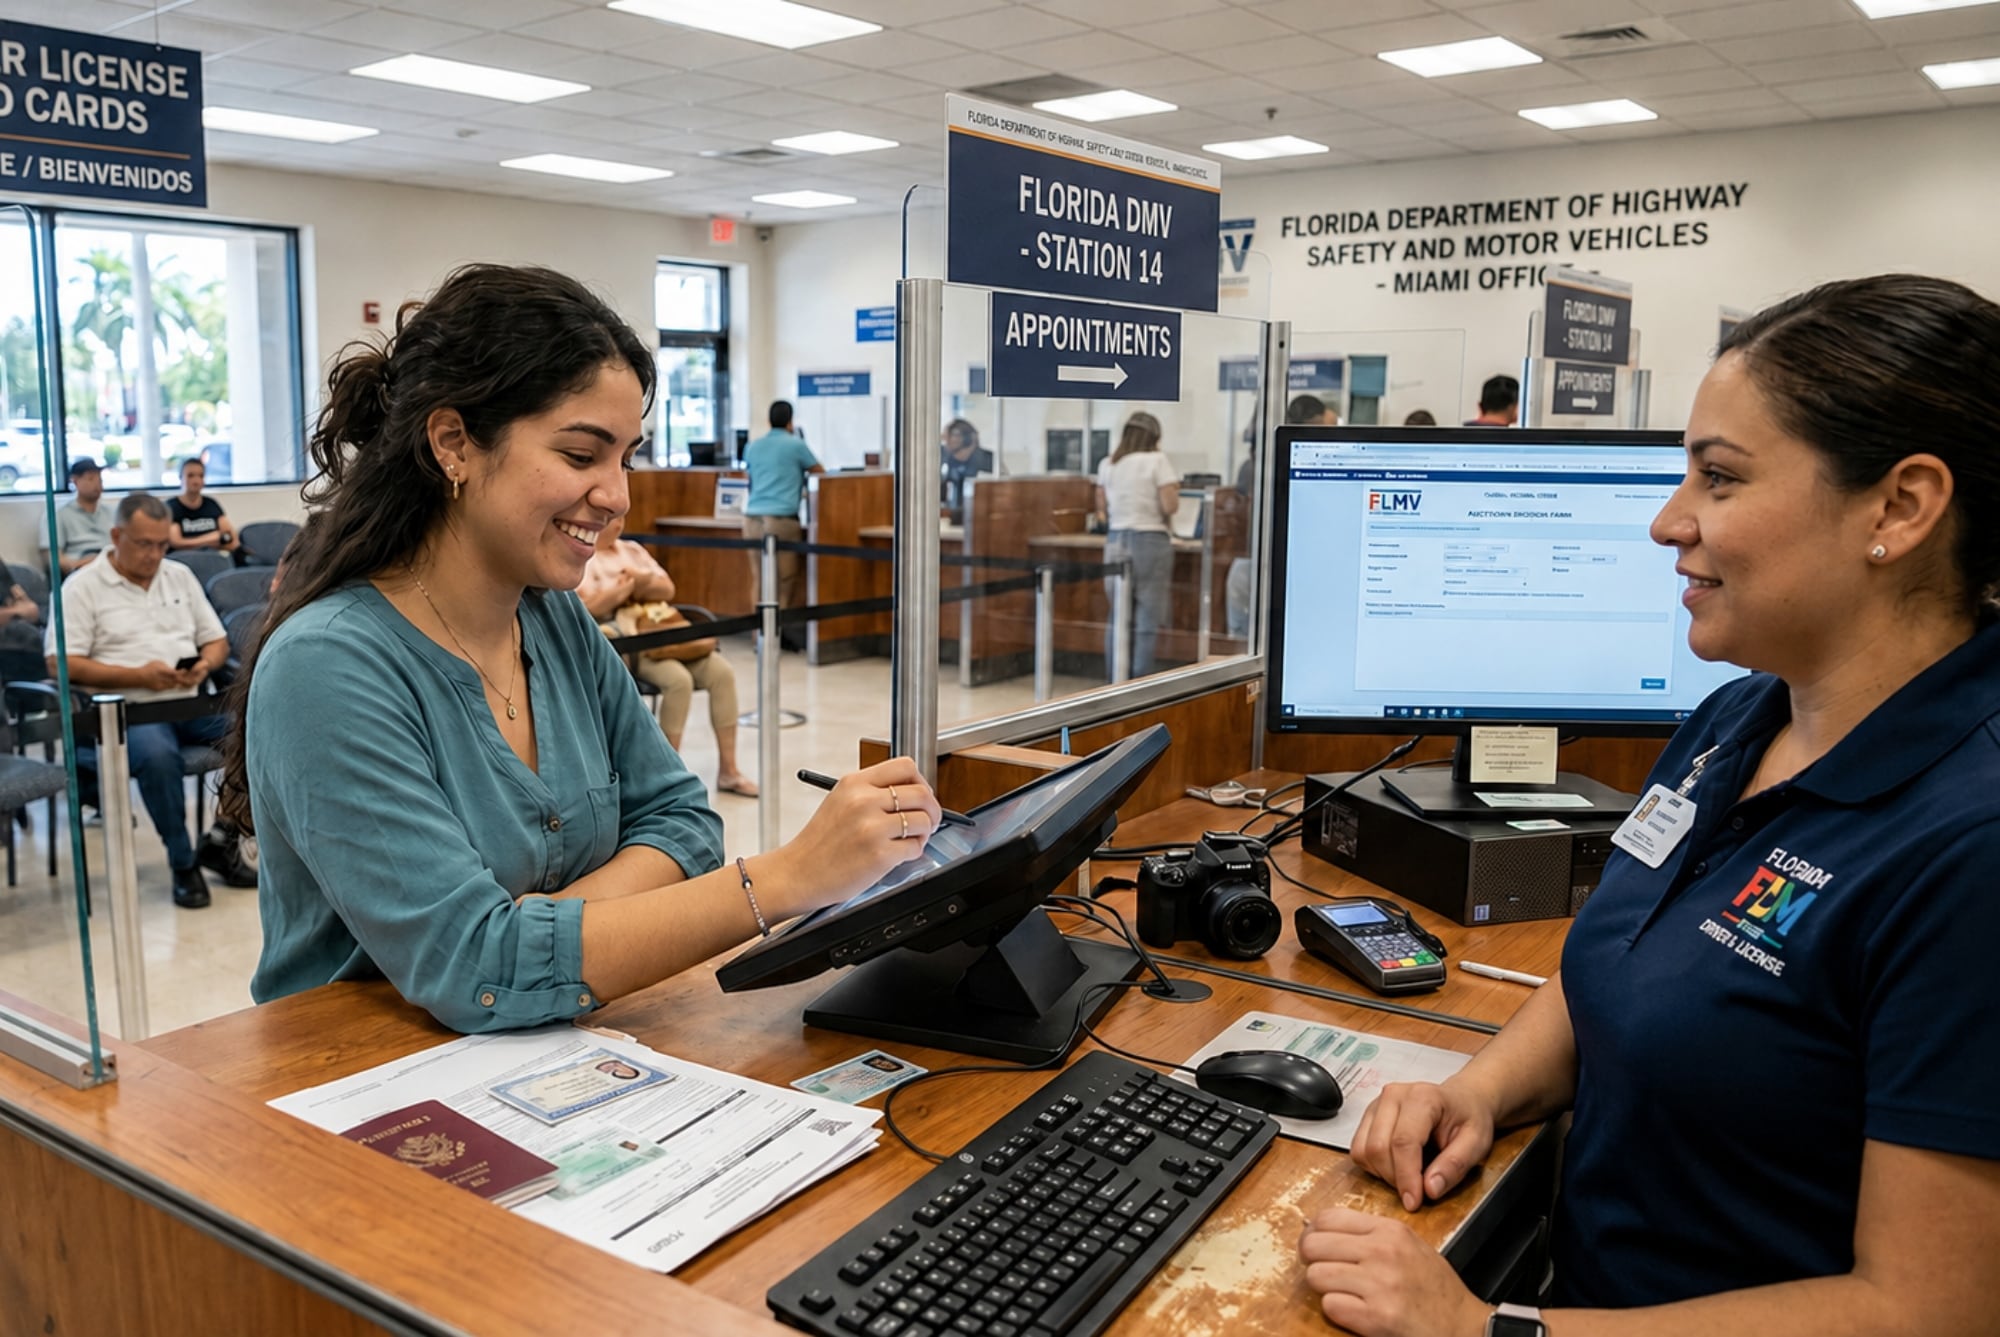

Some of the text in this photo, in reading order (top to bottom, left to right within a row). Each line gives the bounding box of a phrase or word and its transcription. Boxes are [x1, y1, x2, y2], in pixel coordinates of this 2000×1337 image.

[0, 40, 190, 99] R LICENSE
[24, 86, 149, 134] CARDS
[22, 155, 33, 178] /
[39, 156, 193, 193] BIENVENIDOS
[1019, 174, 1173, 239] FLORIDA DMV
[1281, 183, 1749, 238] FLORIDA DEPARTMENT OF HIGHWAY
[1036, 231, 1131, 281] STATION
[1139, 249, 1163, 285] 14
[1220, 233, 1254, 273] V
[1307, 222, 1709, 267] SAFETY AND MOTOR VEHICLES
[1393, 268, 1470, 294] MIAMI
[1478, 264, 1562, 290] OFFI
[1005, 311, 1172, 358] APPOINTMENTS
[1368, 493, 1422, 511] FLMV
[1734, 940, 1786, 977] LICENSE
